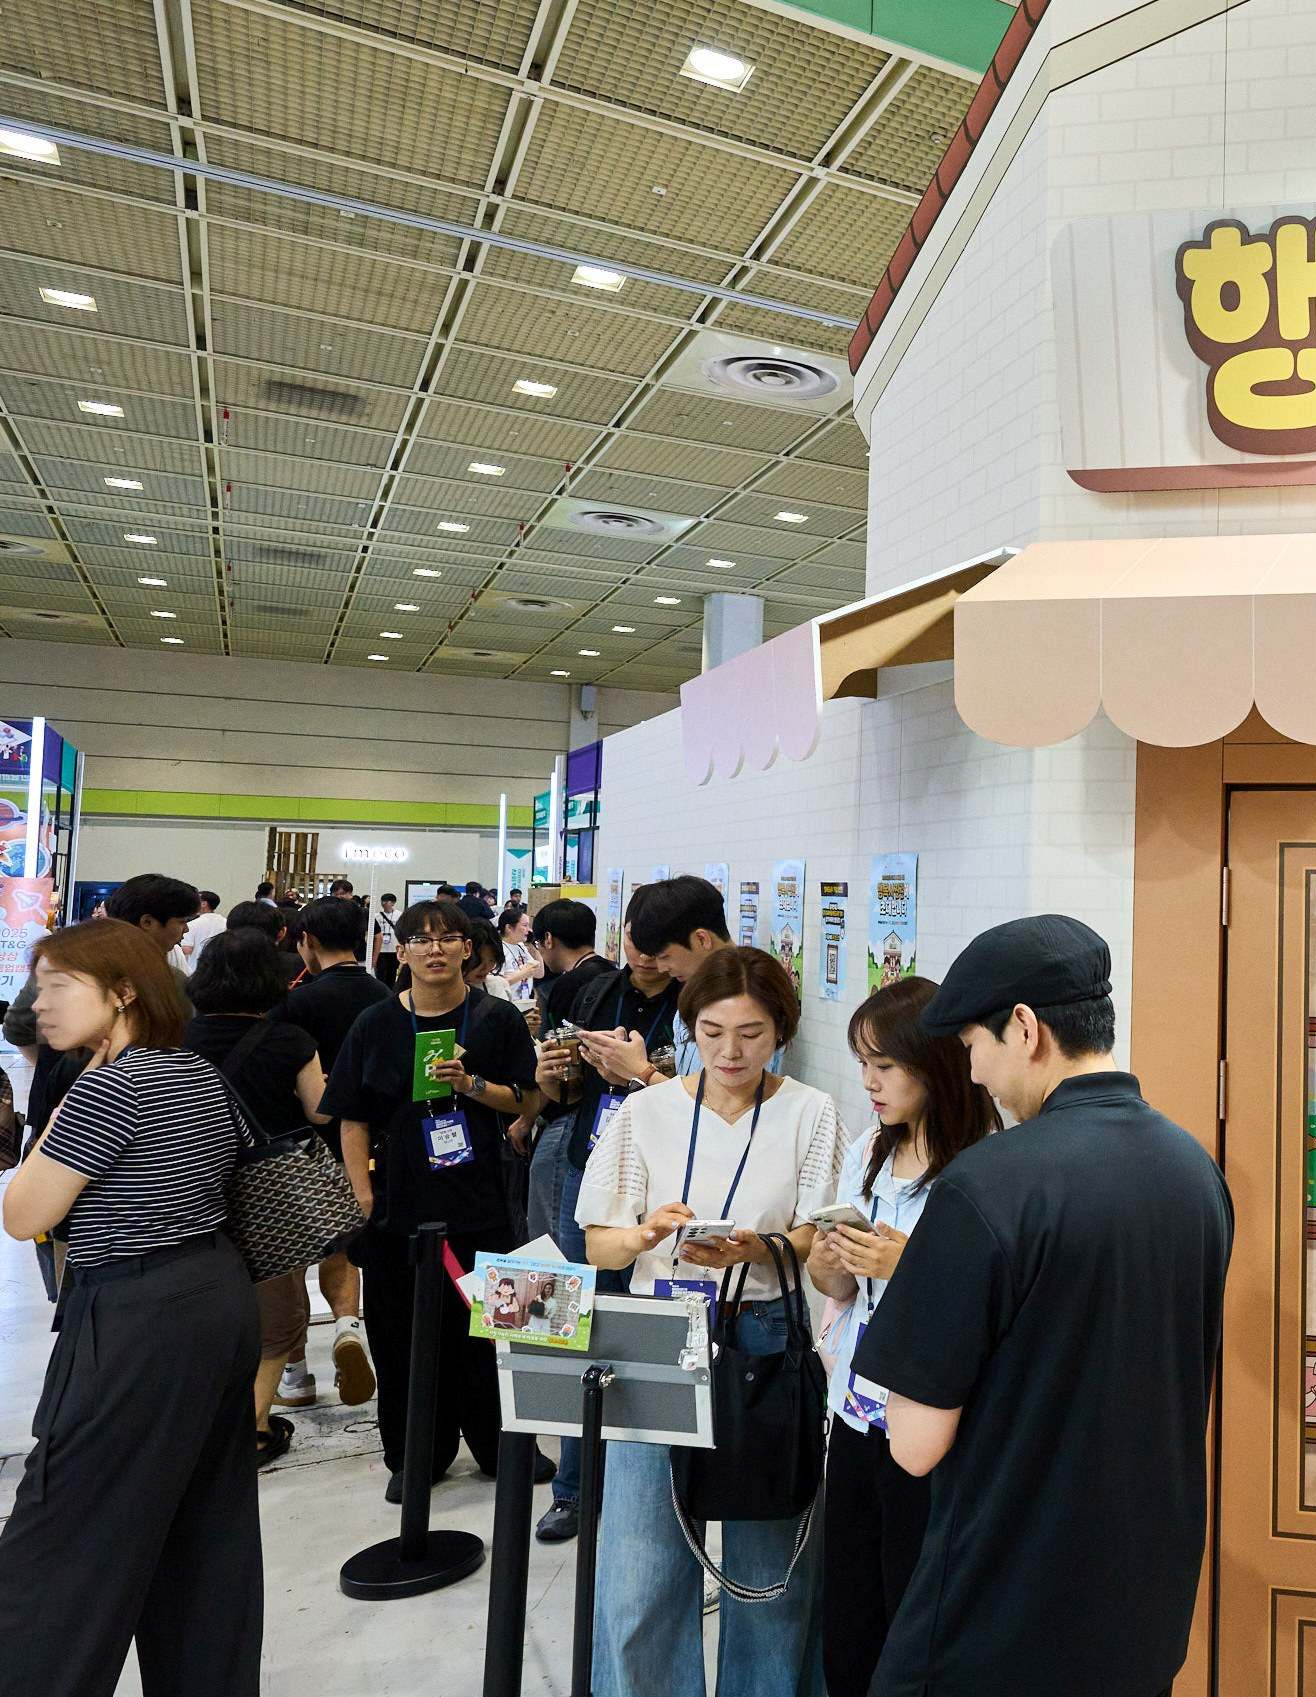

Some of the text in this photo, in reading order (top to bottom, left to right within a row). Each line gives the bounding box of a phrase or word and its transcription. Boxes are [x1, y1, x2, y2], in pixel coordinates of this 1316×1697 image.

[0, 928, 28, 938] 025
[0, 940, 26, 949] T&G
[0, 976, 14, 986] 기
